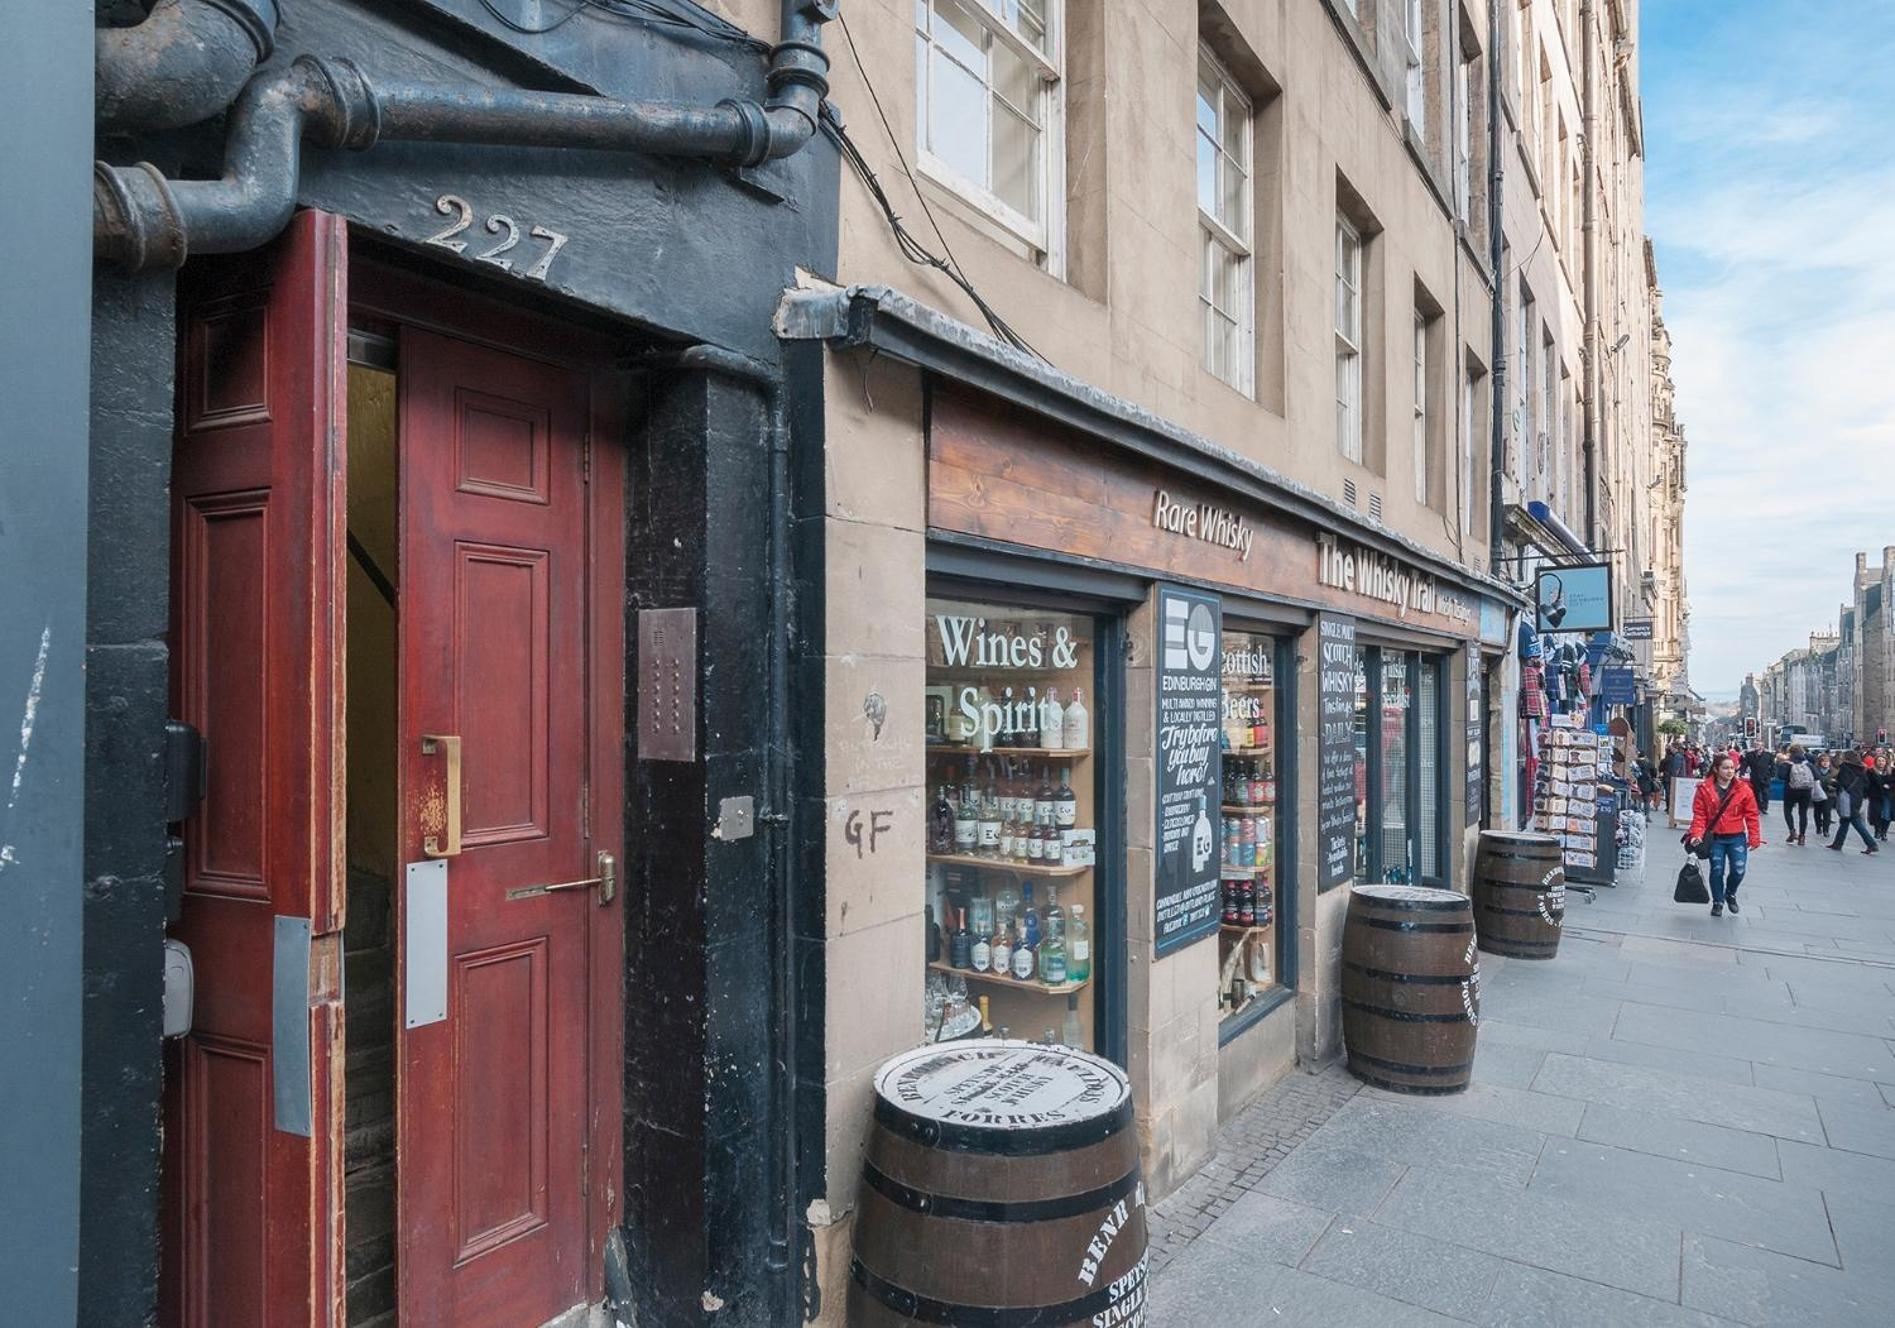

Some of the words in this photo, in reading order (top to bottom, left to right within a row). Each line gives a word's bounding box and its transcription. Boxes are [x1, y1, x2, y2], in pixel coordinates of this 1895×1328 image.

[426, 194, 568, 281] 227
[1156, 490, 1197, 537] Rare
[1199, 503, 1254, 561] Whisky
[1317, 533, 1355, 591] The
[1356, 547, 1410, 618] Whisky
[1411, 570, 1436, 614] Trail
[936, 614, 1042, 667] Wines
[1052, 626, 1078, 668] &
[1164, 598, 1215, 671] EG
[1321, 621, 1340, 638] SINGLE
[1221, 645, 1268, 675] cottish
[1323, 642, 1353, 671] SCOTCH
[1163, 676, 1205, 690] EDINBURGH
[1321, 671, 1354, 692] WHISKY
[1160, 725, 1187, 750] Try
[1188, 722, 1218, 745] before
[1167, 749, 1189, 773] you
[1189, 742, 1209, 767] buy
[984, 1073, 1035, 1099] SCOTCH
[1001, 1076, 1054, 1106] WHISKY
[940, 1109, 1066, 1126] FORRES
